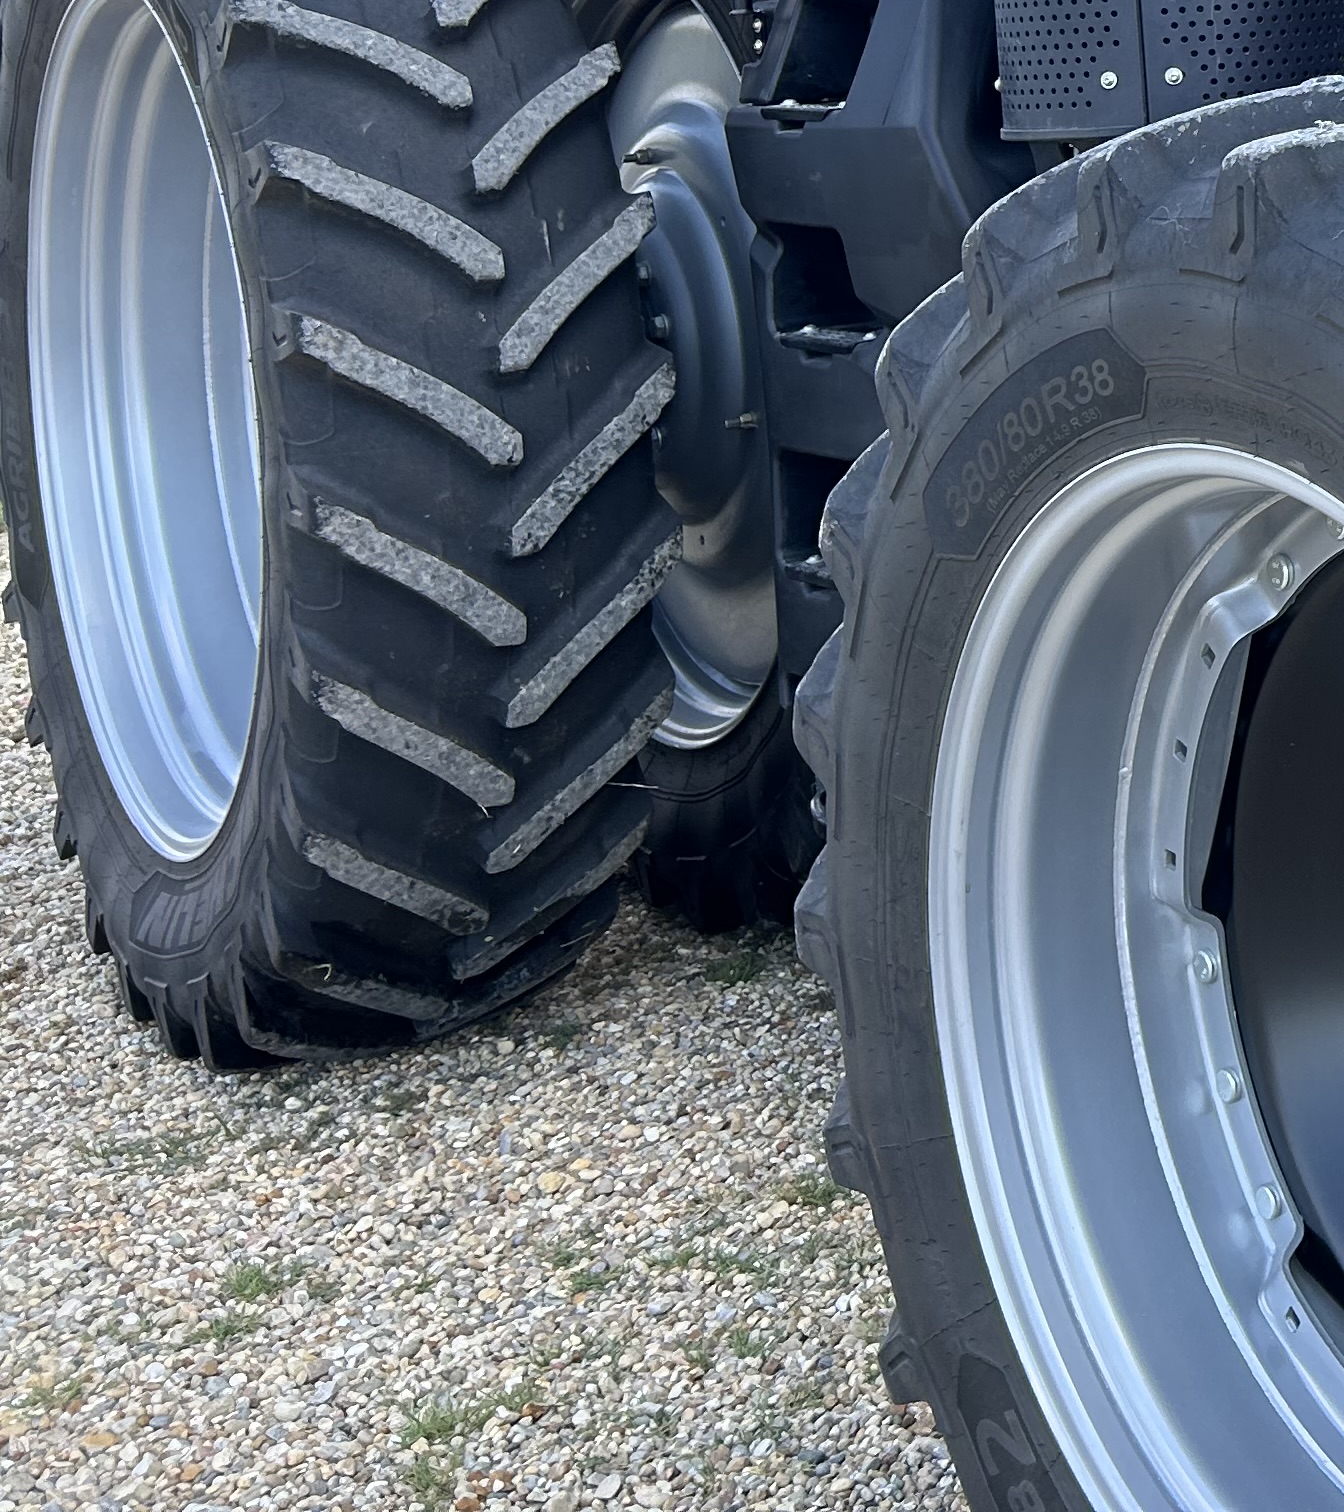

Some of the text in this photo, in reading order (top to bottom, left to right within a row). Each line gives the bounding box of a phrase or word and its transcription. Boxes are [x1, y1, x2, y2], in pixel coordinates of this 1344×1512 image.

[946, 358, 1115, 528] 380/80R38
[1007, 444, 1048, 484] Replace
[977, 1409, 1037, 1477] 2
